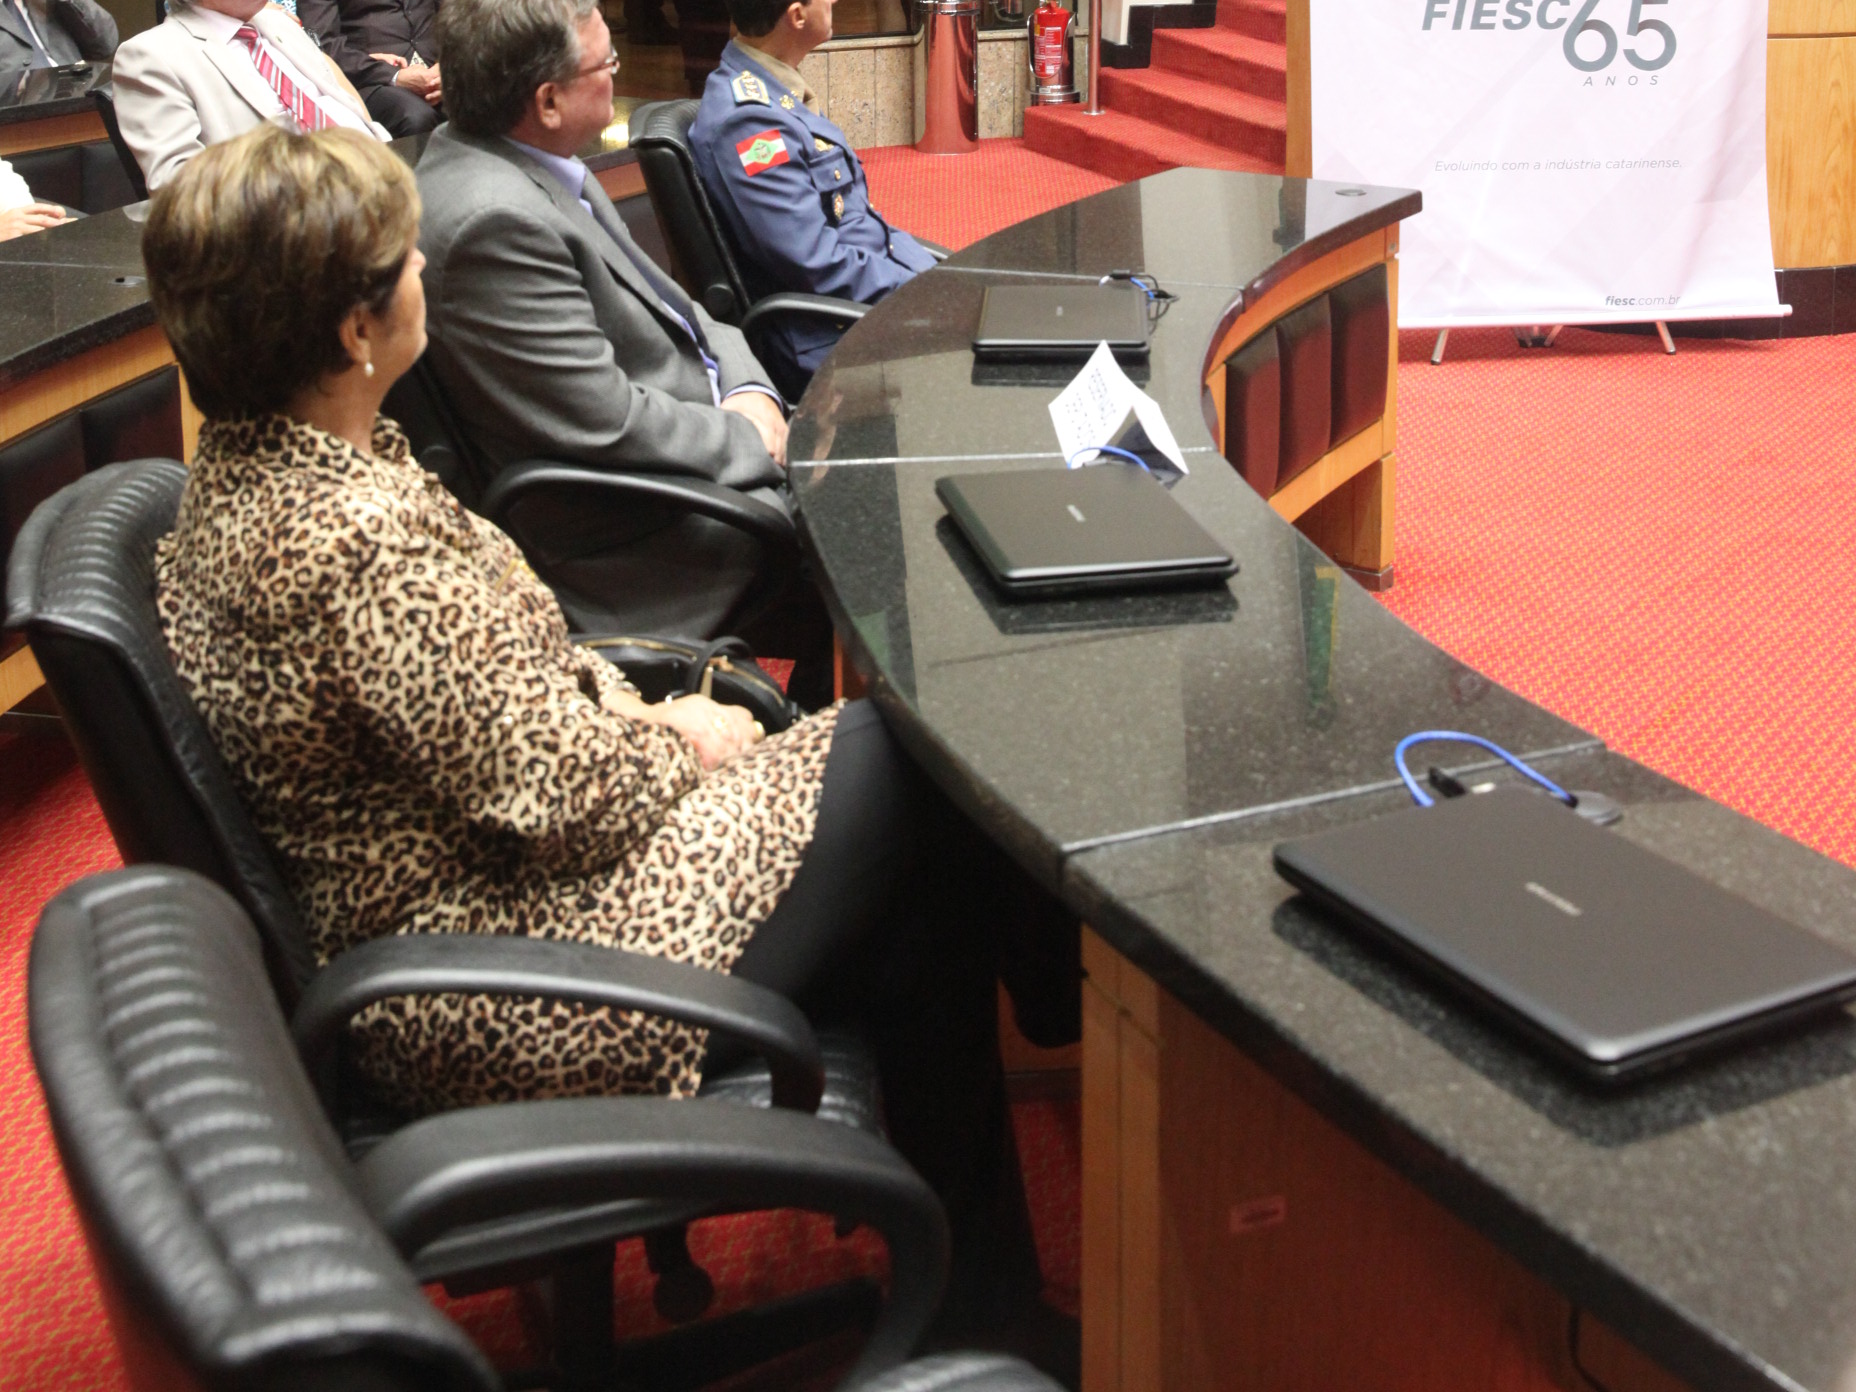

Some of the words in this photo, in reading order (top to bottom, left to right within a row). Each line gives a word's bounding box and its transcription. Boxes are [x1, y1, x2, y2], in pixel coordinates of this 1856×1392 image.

[1583, 75, 1659, 87] ANOS
[1434, 159, 1498, 172] Evoluindo
[1501, 161, 1530, 171] com
[1533, 161, 1541, 170] a
[1545, 158, 1601, 170] indústria
[1605, 158, 1683, 170] catarinense.
[1605, 295, 1681, 306] fiesc.com.br
